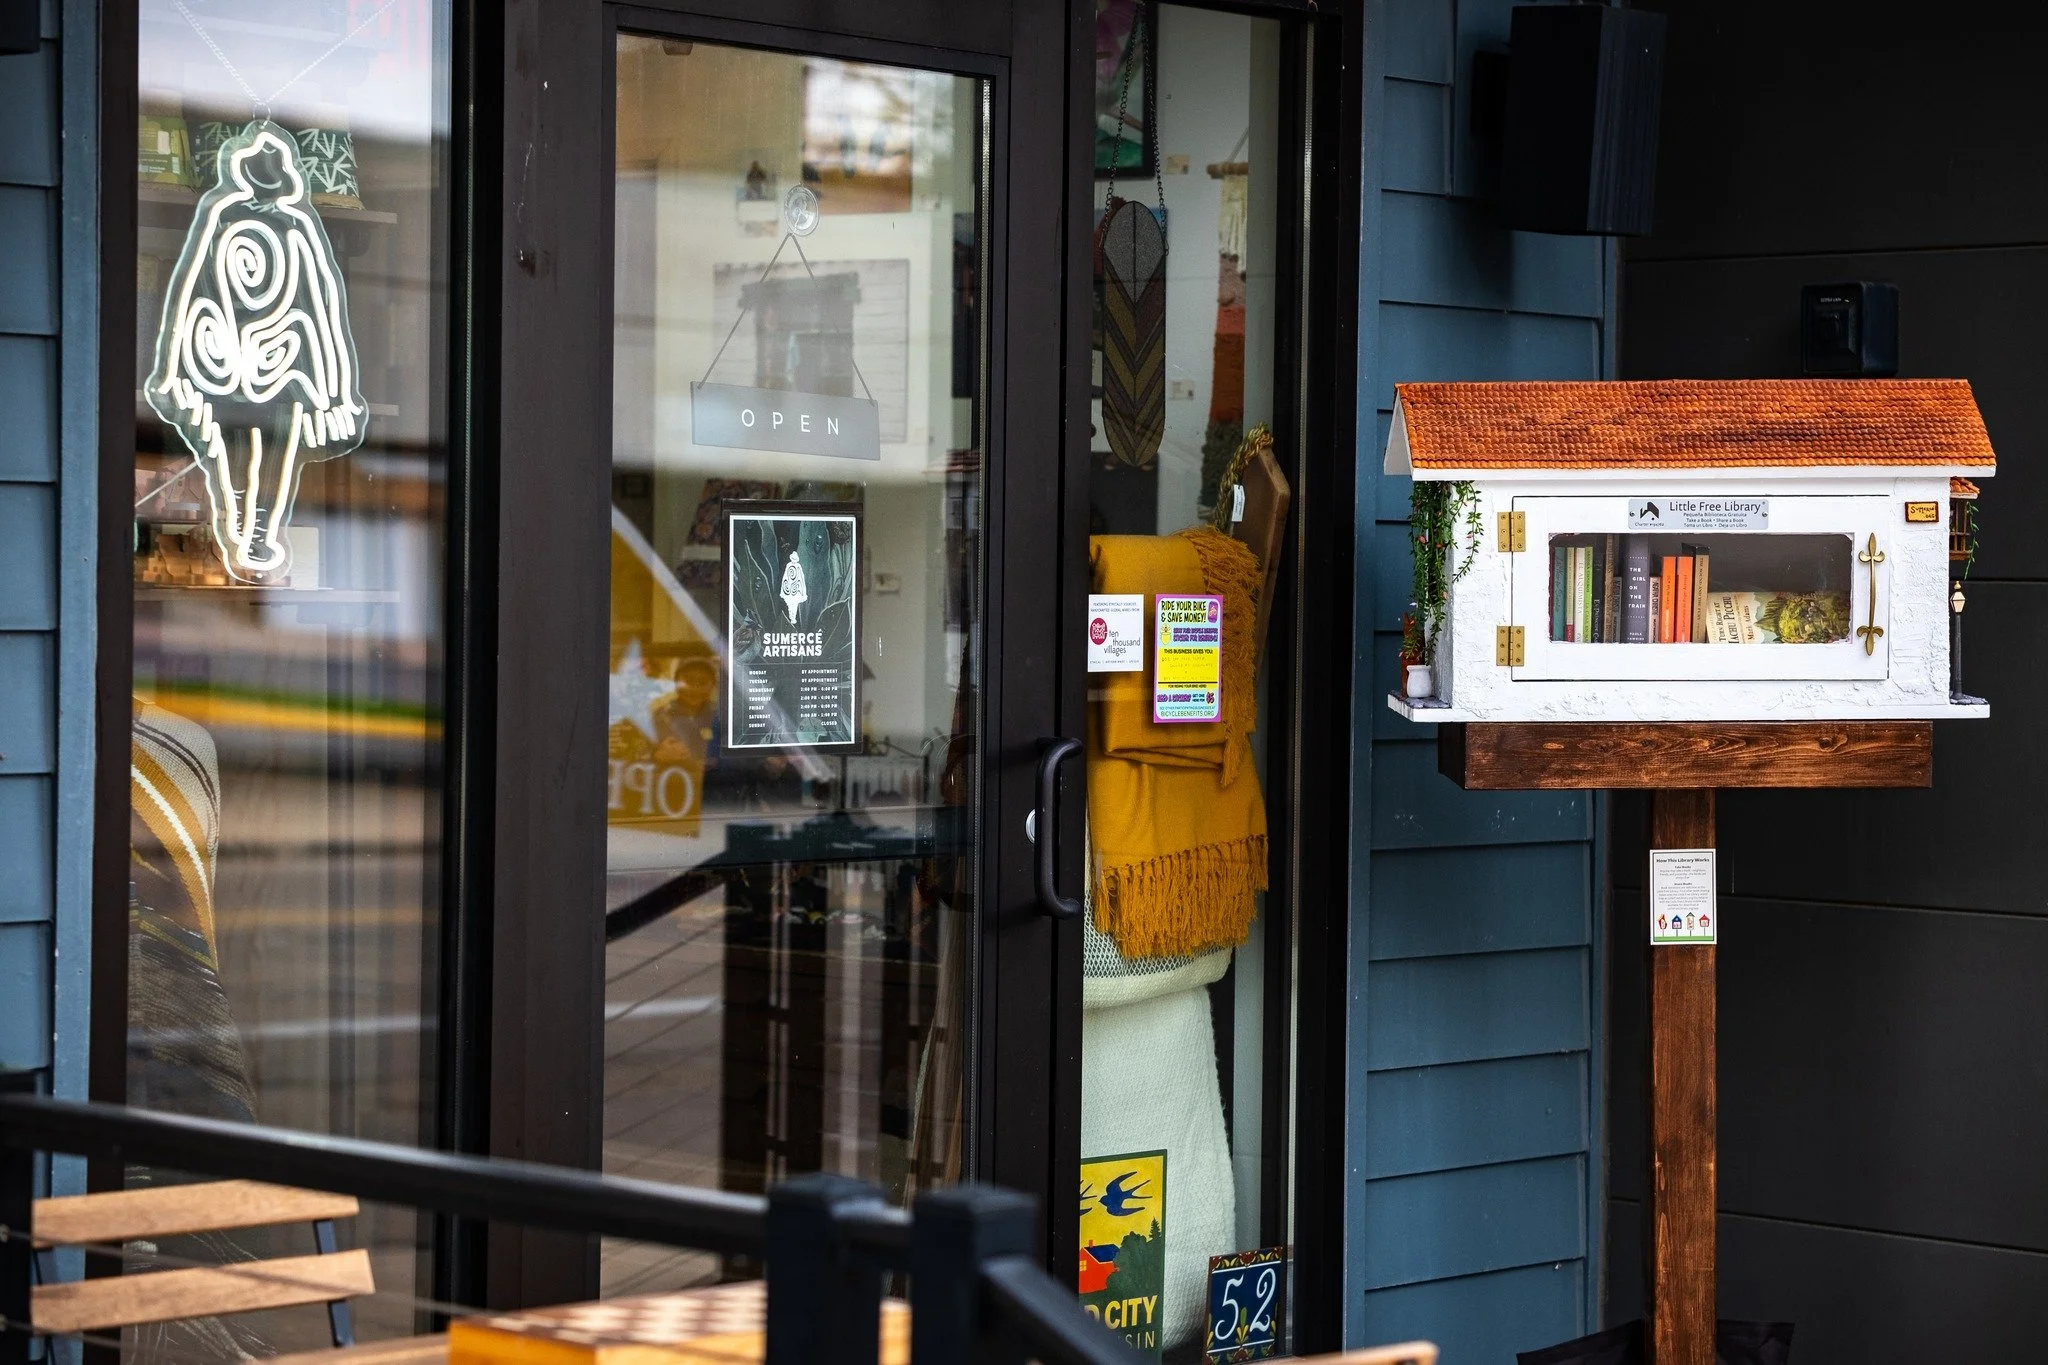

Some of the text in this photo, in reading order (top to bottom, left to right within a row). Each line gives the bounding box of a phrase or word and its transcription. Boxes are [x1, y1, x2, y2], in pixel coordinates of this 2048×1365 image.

[741, 409, 839, 436] OPEN
[1669, 501, 1761, 514] Little Free Library
[1161, 601, 1206, 611] RIDE YOUR BIKE
[1722, 597, 1735, 620] PICCHU
[1161, 612, 1206, 623] & SAVE MONEY!
[763, 629, 823, 645] SUMERCÉ
[1109, 630, 1119, 638] ten
[1112, 637, 1141, 647] thousand
[763, 645, 823, 657] ARTISANS
[1104, 645, 1127, 657] villages
[1214, 1267, 1277, 1341] 52
[1105, 1295, 1158, 1330] CITY
